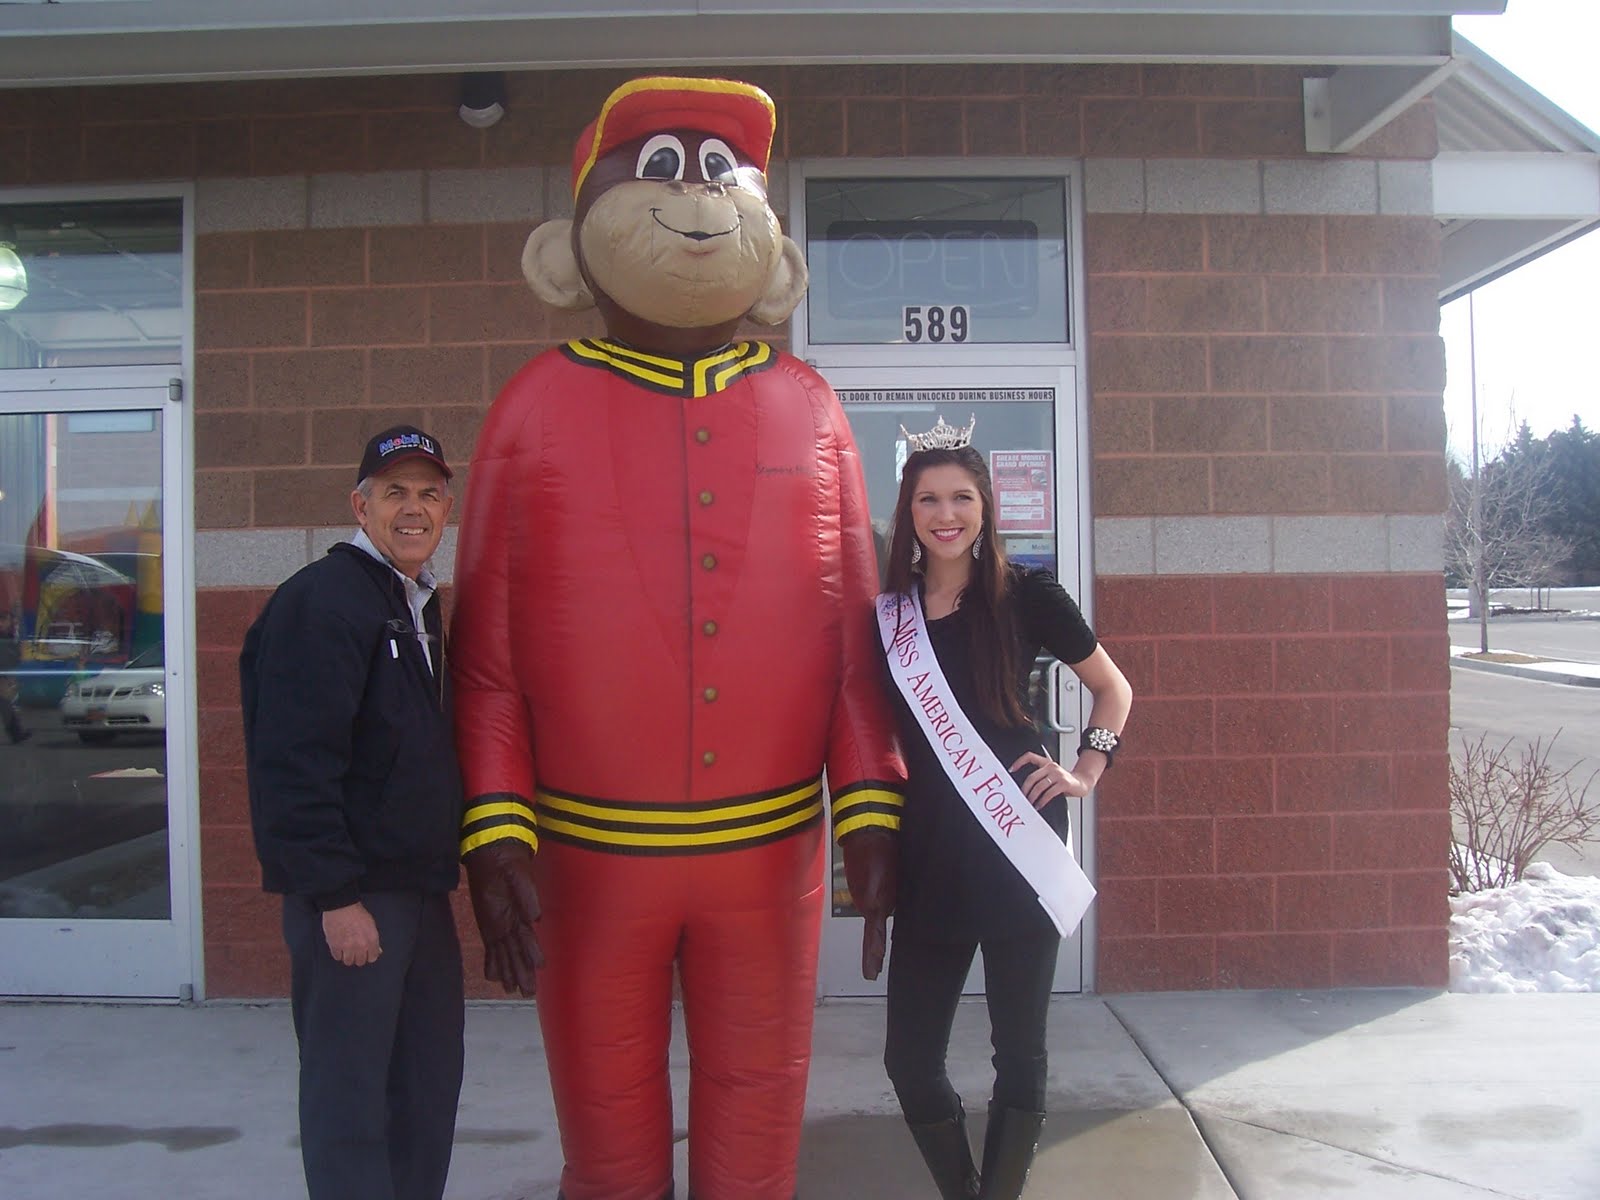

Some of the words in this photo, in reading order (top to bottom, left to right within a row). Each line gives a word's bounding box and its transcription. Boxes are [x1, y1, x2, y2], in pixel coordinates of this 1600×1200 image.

[838, 230, 1028, 289] OPEN
[904, 305, 968, 342] 589
[849, 392, 870, 401] DOOR
[872, 392, 883, 401] TO
[885, 392, 914, 401] REMAIN
[916, 391, 956, 400] UNLOCKED
[958, 391, 987, 400] DURING
[989, 391, 1026, 400] BUSINESS
[1028, 390, 1053, 400] HOURS
[379, 433, 421, 454] Mobil
[906, 671, 983, 779] AMERICAN
[972, 772, 1026, 838] FORK
